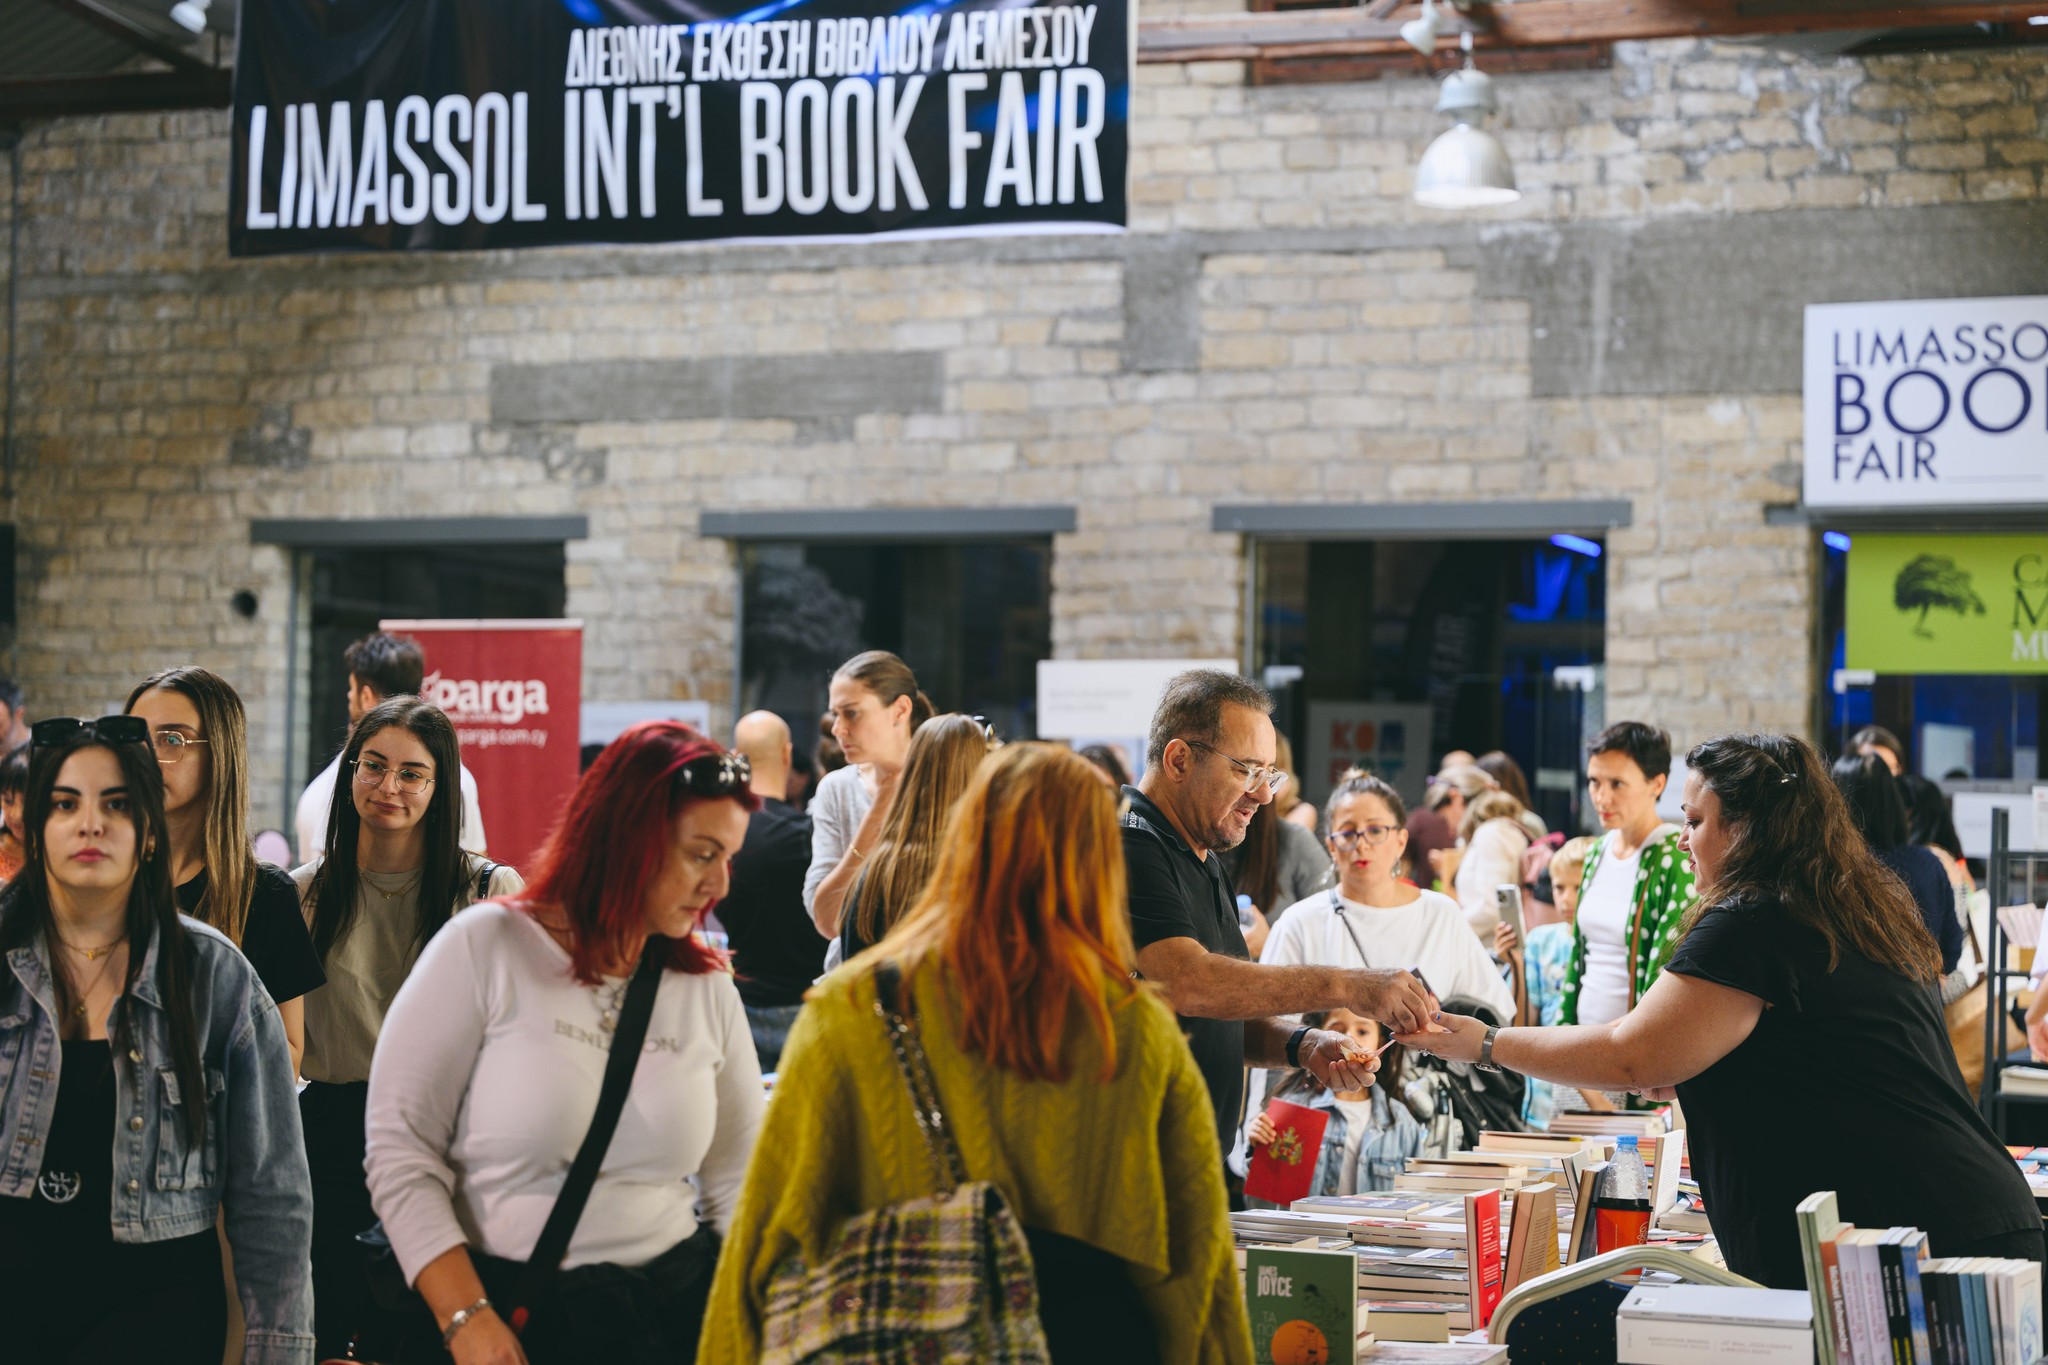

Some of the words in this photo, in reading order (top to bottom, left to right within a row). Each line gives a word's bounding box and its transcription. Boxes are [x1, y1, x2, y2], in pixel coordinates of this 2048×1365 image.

[564, 24, 688, 87] ΔΙΕΘΝΗΣ
[691, 20, 812, 82] ΕΚΘΕΣΗ
[815, 14, 941, 77] ΒΙΒΛΙΟΥ
[942, 5, 1097, 71] ΛΕΜΕΣΟΥ
[246, 91, 547, 230] LIMASSOL
[564, 84, 724, 221] INT'L
[740, 75, 930, 216] BOOK
[947, 67, 1106, 210] FAIR
[1834, 365, 2048, 436] BOO
[1833, 439, 1938, 482] FAIR
[1257, 1274, 1293, 1297] JOYCE
